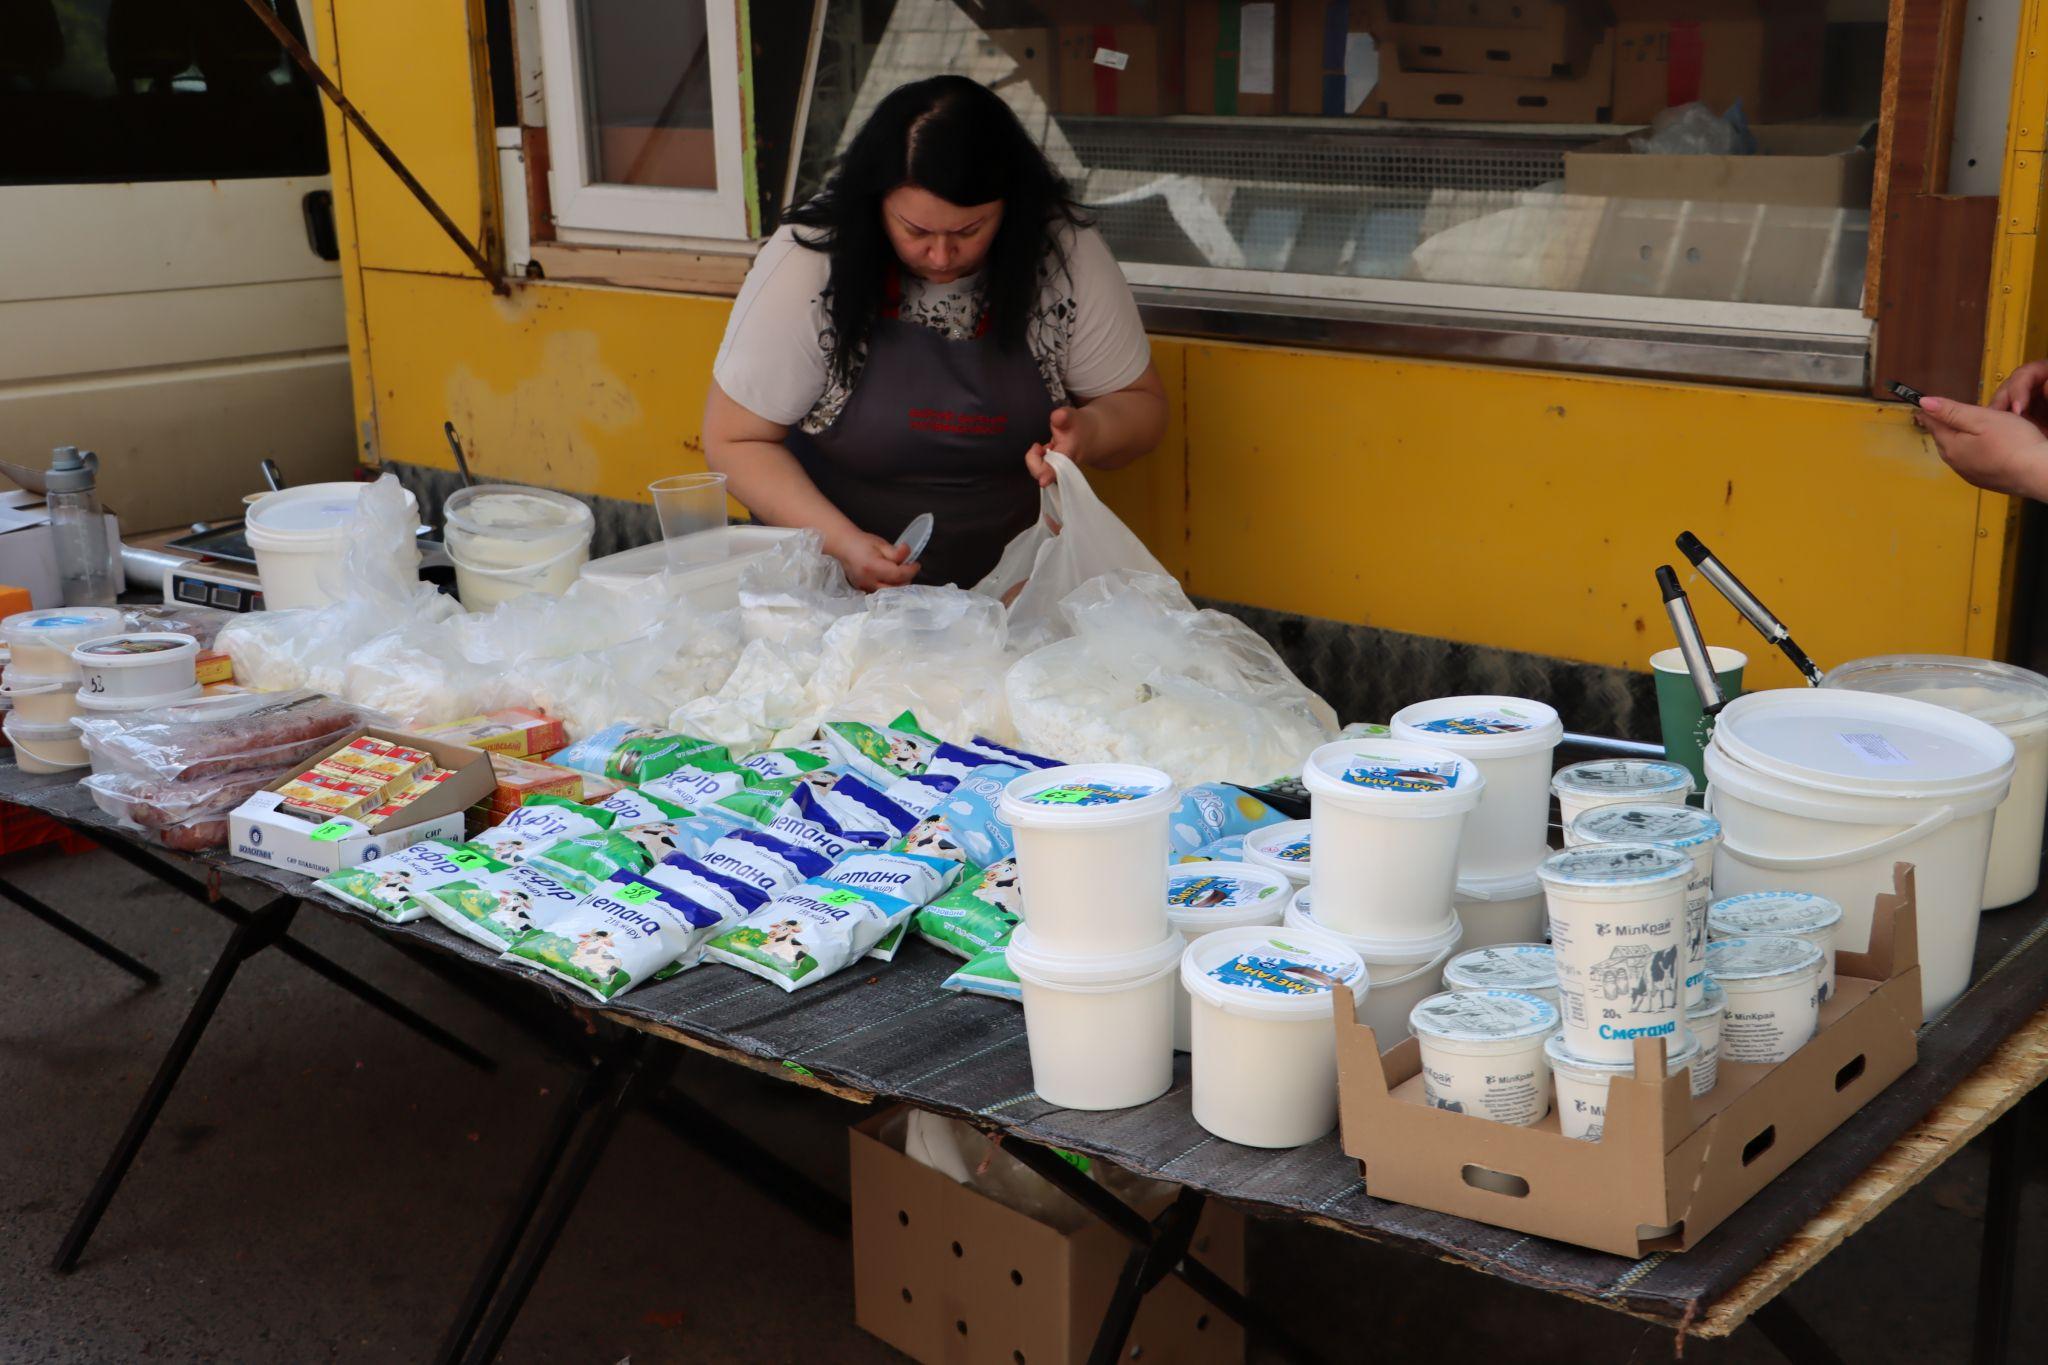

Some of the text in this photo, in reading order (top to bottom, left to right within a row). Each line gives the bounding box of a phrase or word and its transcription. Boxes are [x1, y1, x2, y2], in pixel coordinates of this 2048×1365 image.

[1353, 775, 1445, 791] СМЕТАНА
[674, 788, 698, 805] жиру
[408, 846, 461, 874] ефір
[515, 866, 577, 900] ефір
[1616, 919, 1672, 937] МілКрай
[1234, 962, 1317, 994] СМЕТАНА
[1734, 1010, 1776, 1021] МілКрай
[1599, 1021, 1676, 1040] Сметана
